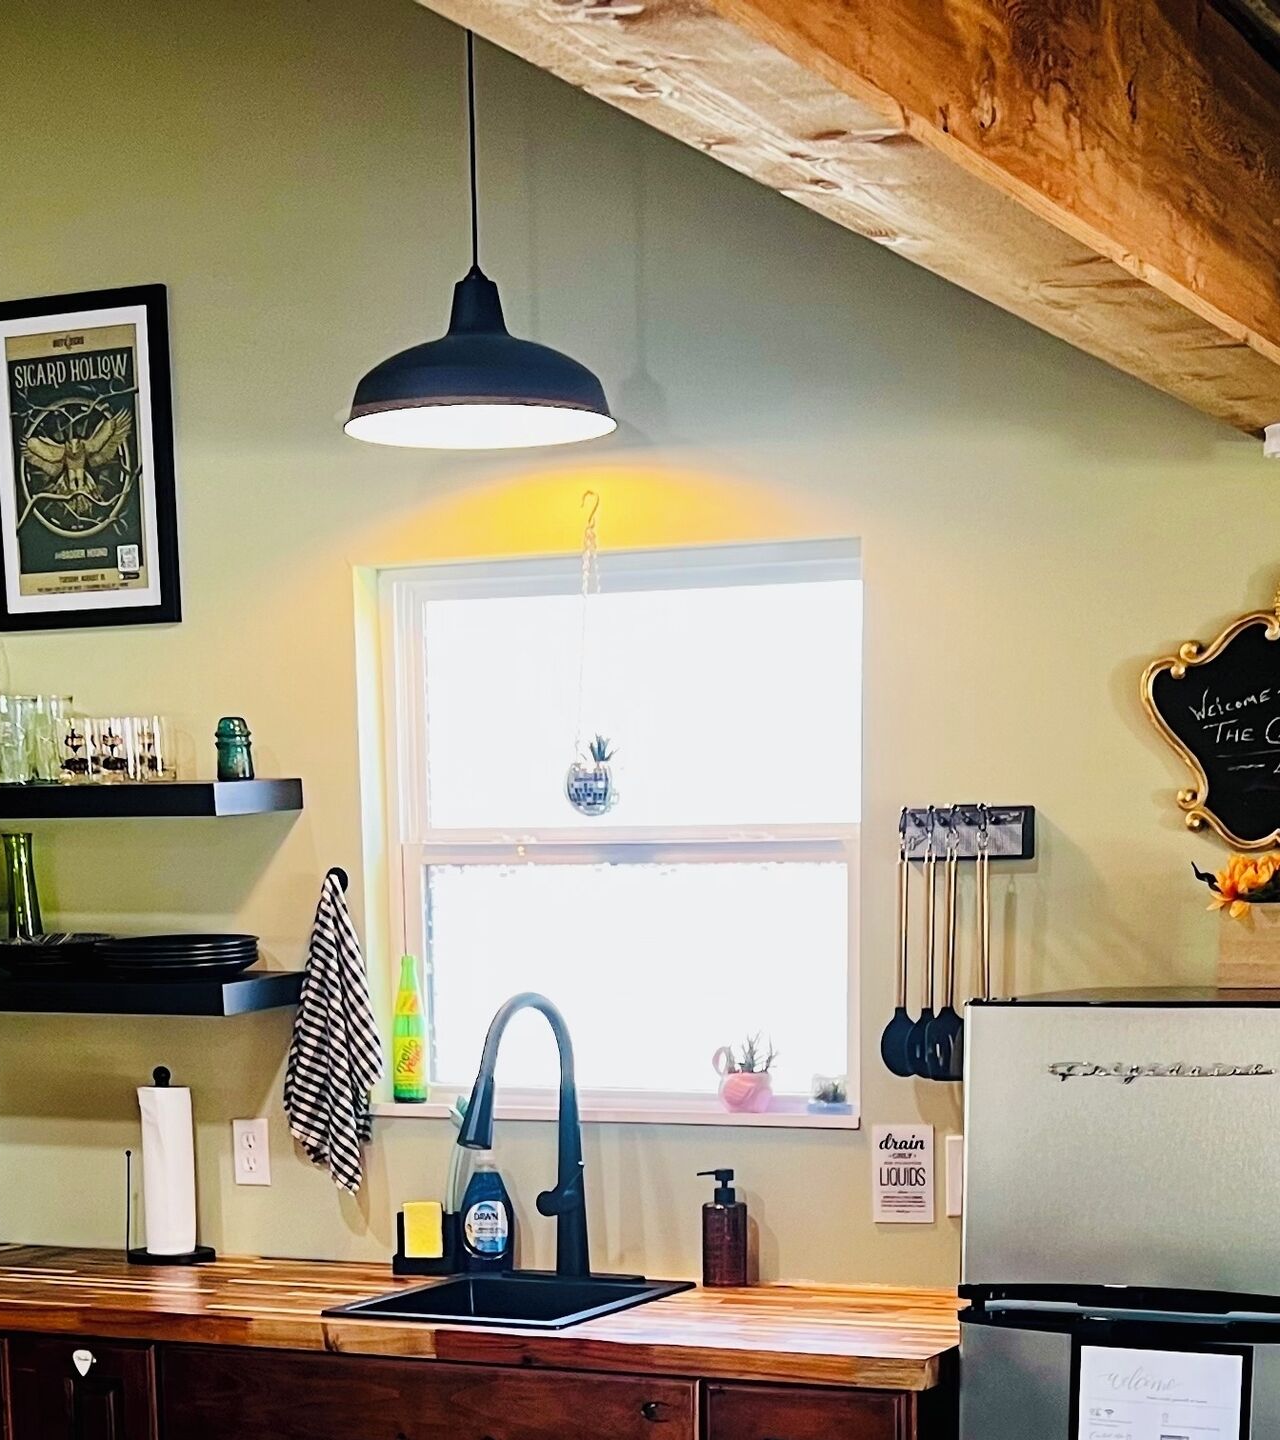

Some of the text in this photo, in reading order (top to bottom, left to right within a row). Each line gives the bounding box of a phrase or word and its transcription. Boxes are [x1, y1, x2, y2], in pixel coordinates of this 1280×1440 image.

[14, 353, 128, 389] SICARD HOLLOW
[1202, 719, 1255, 744] THE
[879, 1133, 925, 1150] drain
[879, 1167, 926, 1187] LIQUIDS
